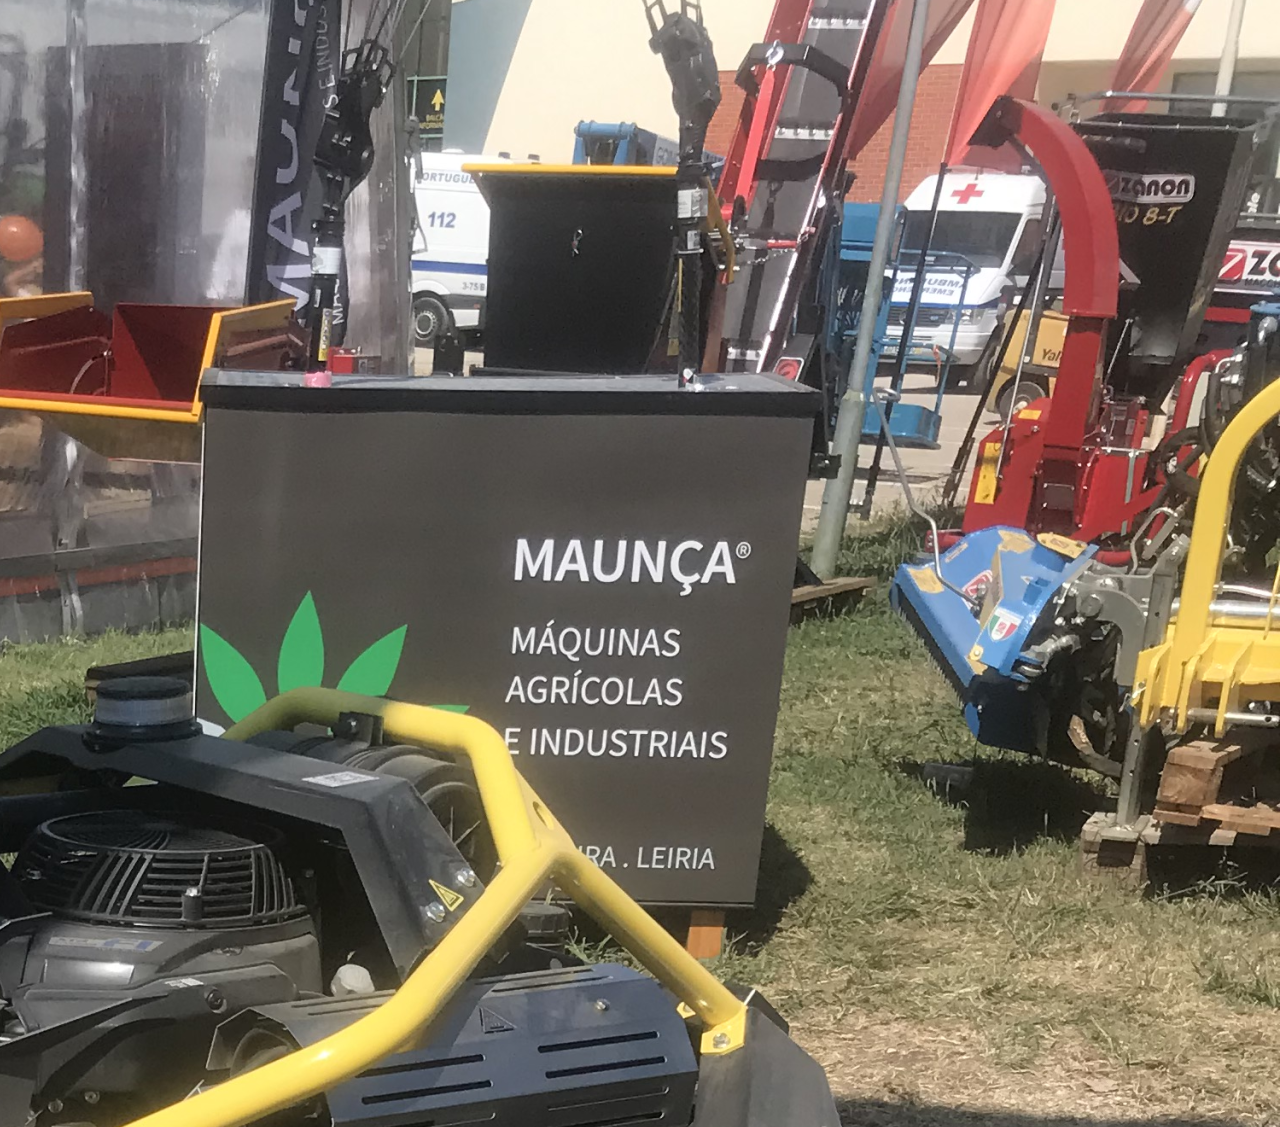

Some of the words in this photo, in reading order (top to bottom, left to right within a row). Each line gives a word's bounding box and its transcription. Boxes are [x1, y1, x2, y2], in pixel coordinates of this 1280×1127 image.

[422, 171, 475, 184] ORTUGUE
[427, 211, 457, 228] 112
[1041, 348, 1062, 361] Yal
[511, 619, 682, 661] MÁQUINAS
[505, 669, 683, 707] AGRÍCOLAS
[504, 727, 521, 755] E
[529, 728, 729, 759] INDUSTRIAIS
[637, 846, 716, 870] LEIRIA
